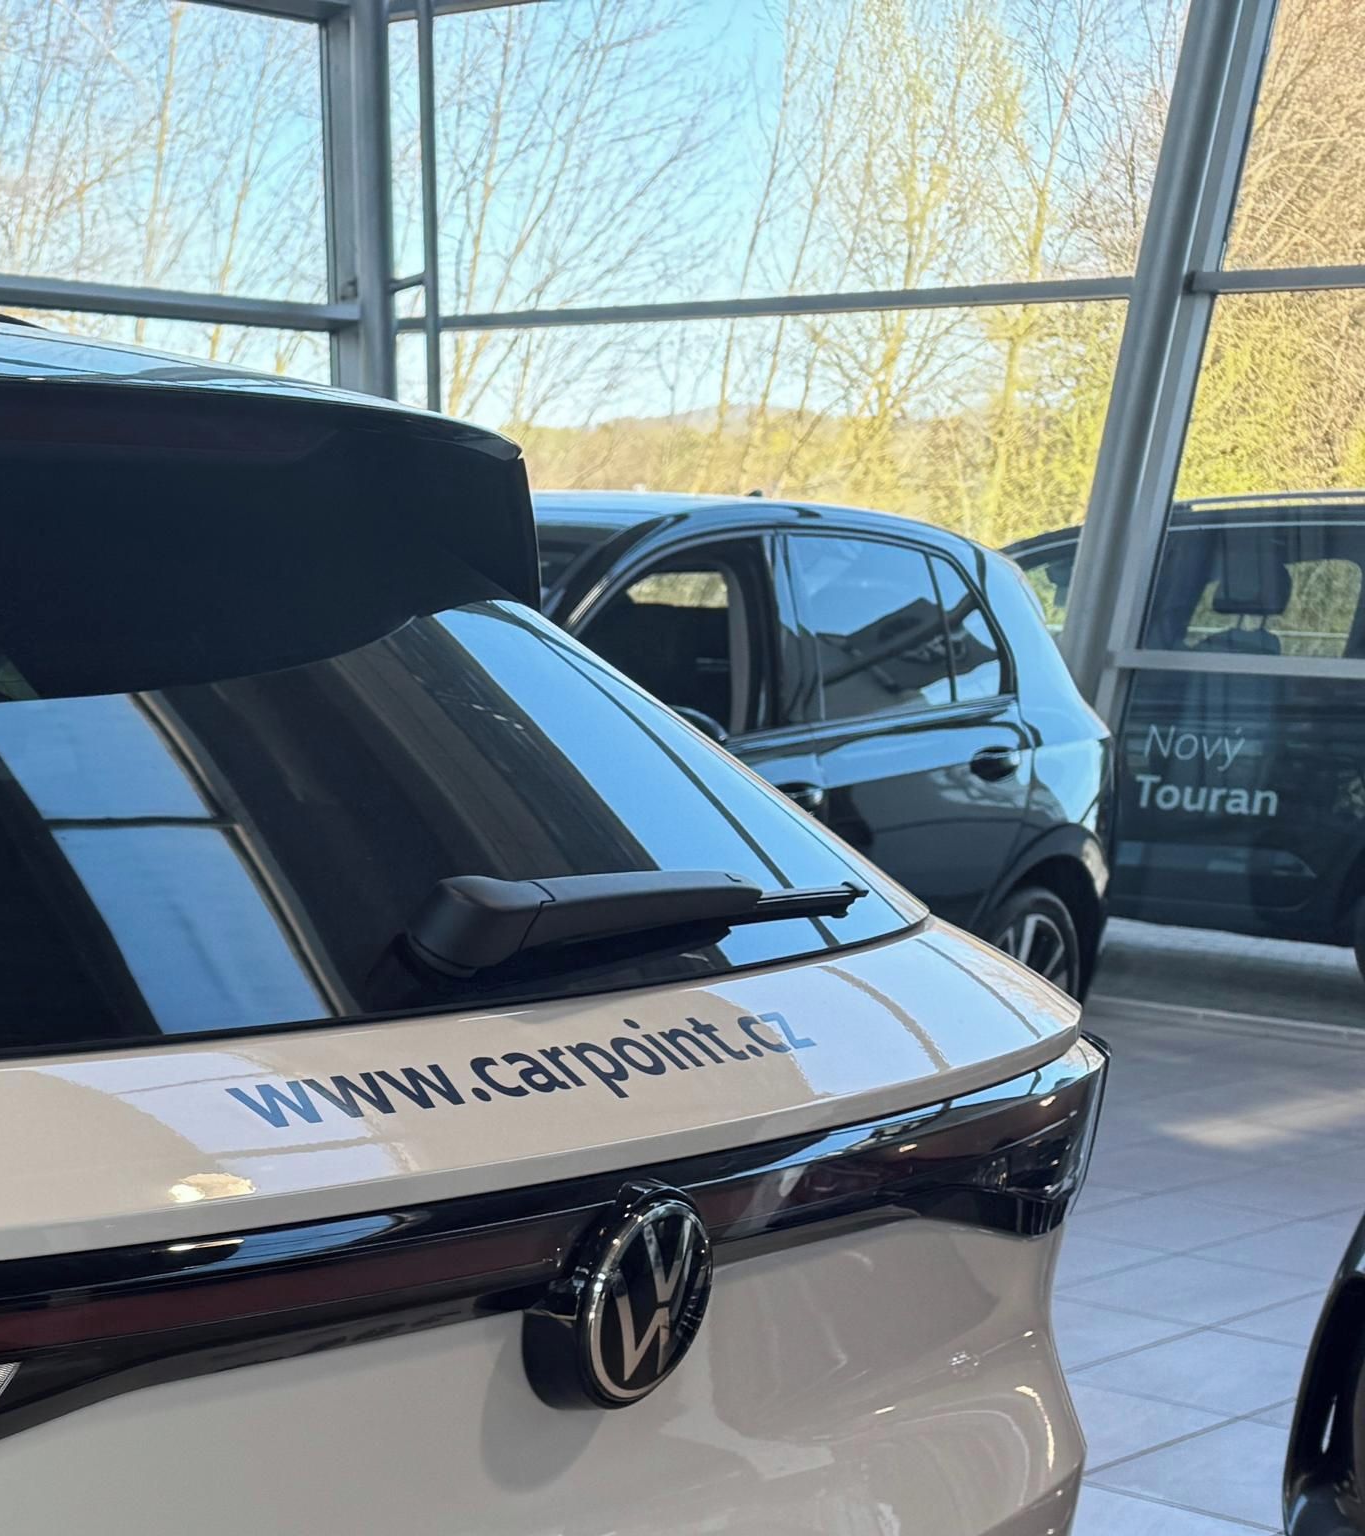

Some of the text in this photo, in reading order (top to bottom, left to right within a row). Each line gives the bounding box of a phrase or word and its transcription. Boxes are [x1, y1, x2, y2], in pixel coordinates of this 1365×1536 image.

[1144, 724, 1246, 771] Nový
[1135, 774, 1279, 817] Touran
[225, 1011, 817, 1129] www.carpoint.cz
